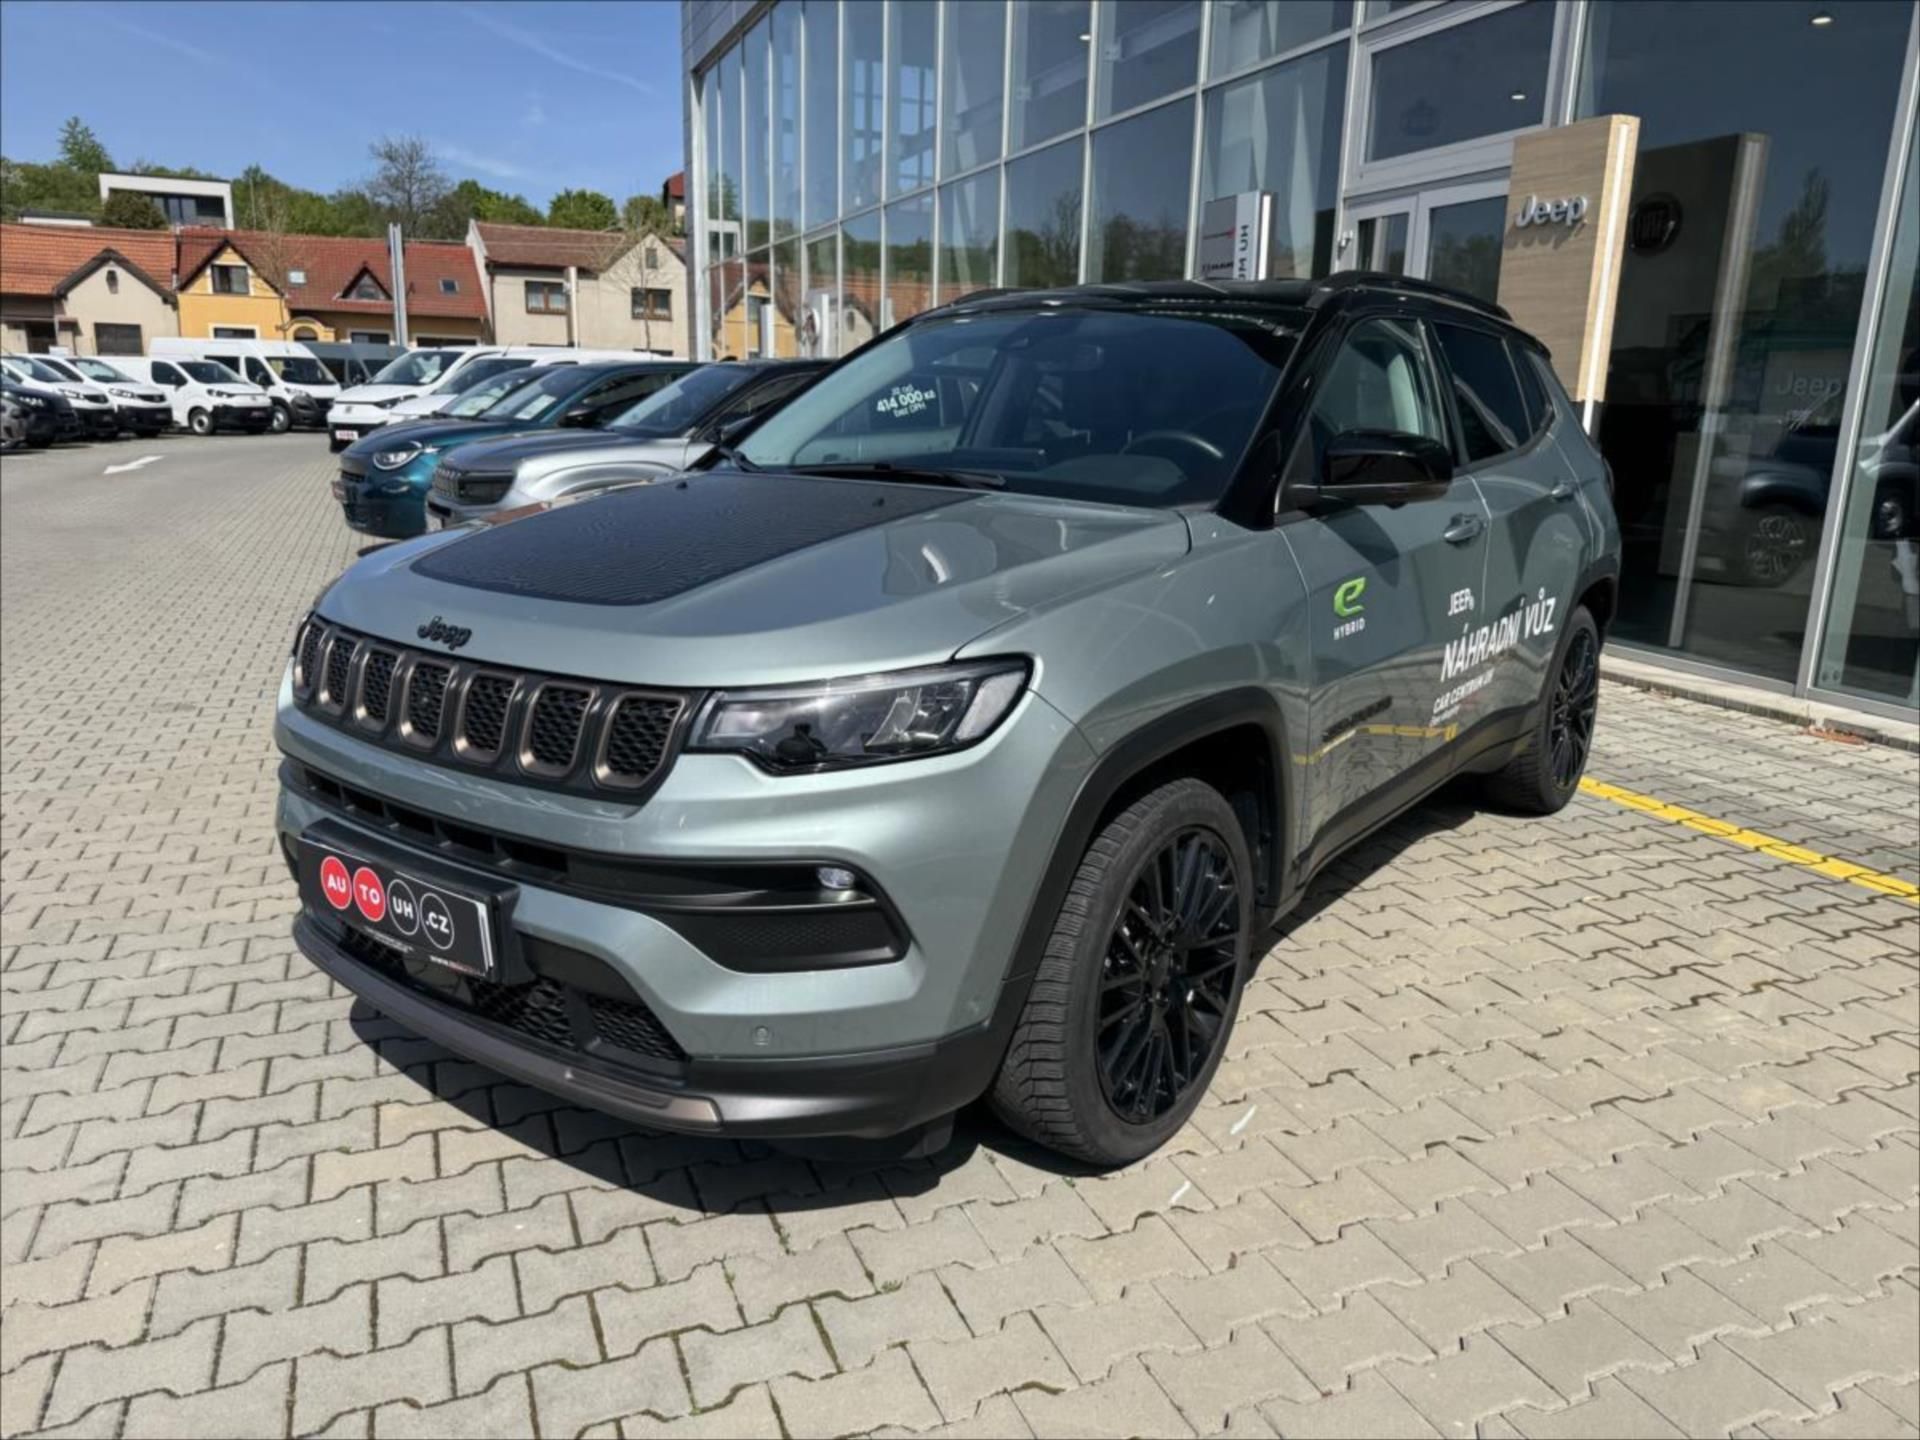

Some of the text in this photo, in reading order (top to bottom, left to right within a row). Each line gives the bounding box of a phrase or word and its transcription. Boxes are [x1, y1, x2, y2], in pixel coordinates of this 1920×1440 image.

[1516, 195, 1588, 227] Jeep
[877, 397, 898, 412] 414
[898, 390, 923, 406] 000
[417, 615, 473, 652] Jeep
[1333, 617, 1366, 641] HYBRID
[1440, 587, 1556, 683] NÁHRADNÍ VŮZ
